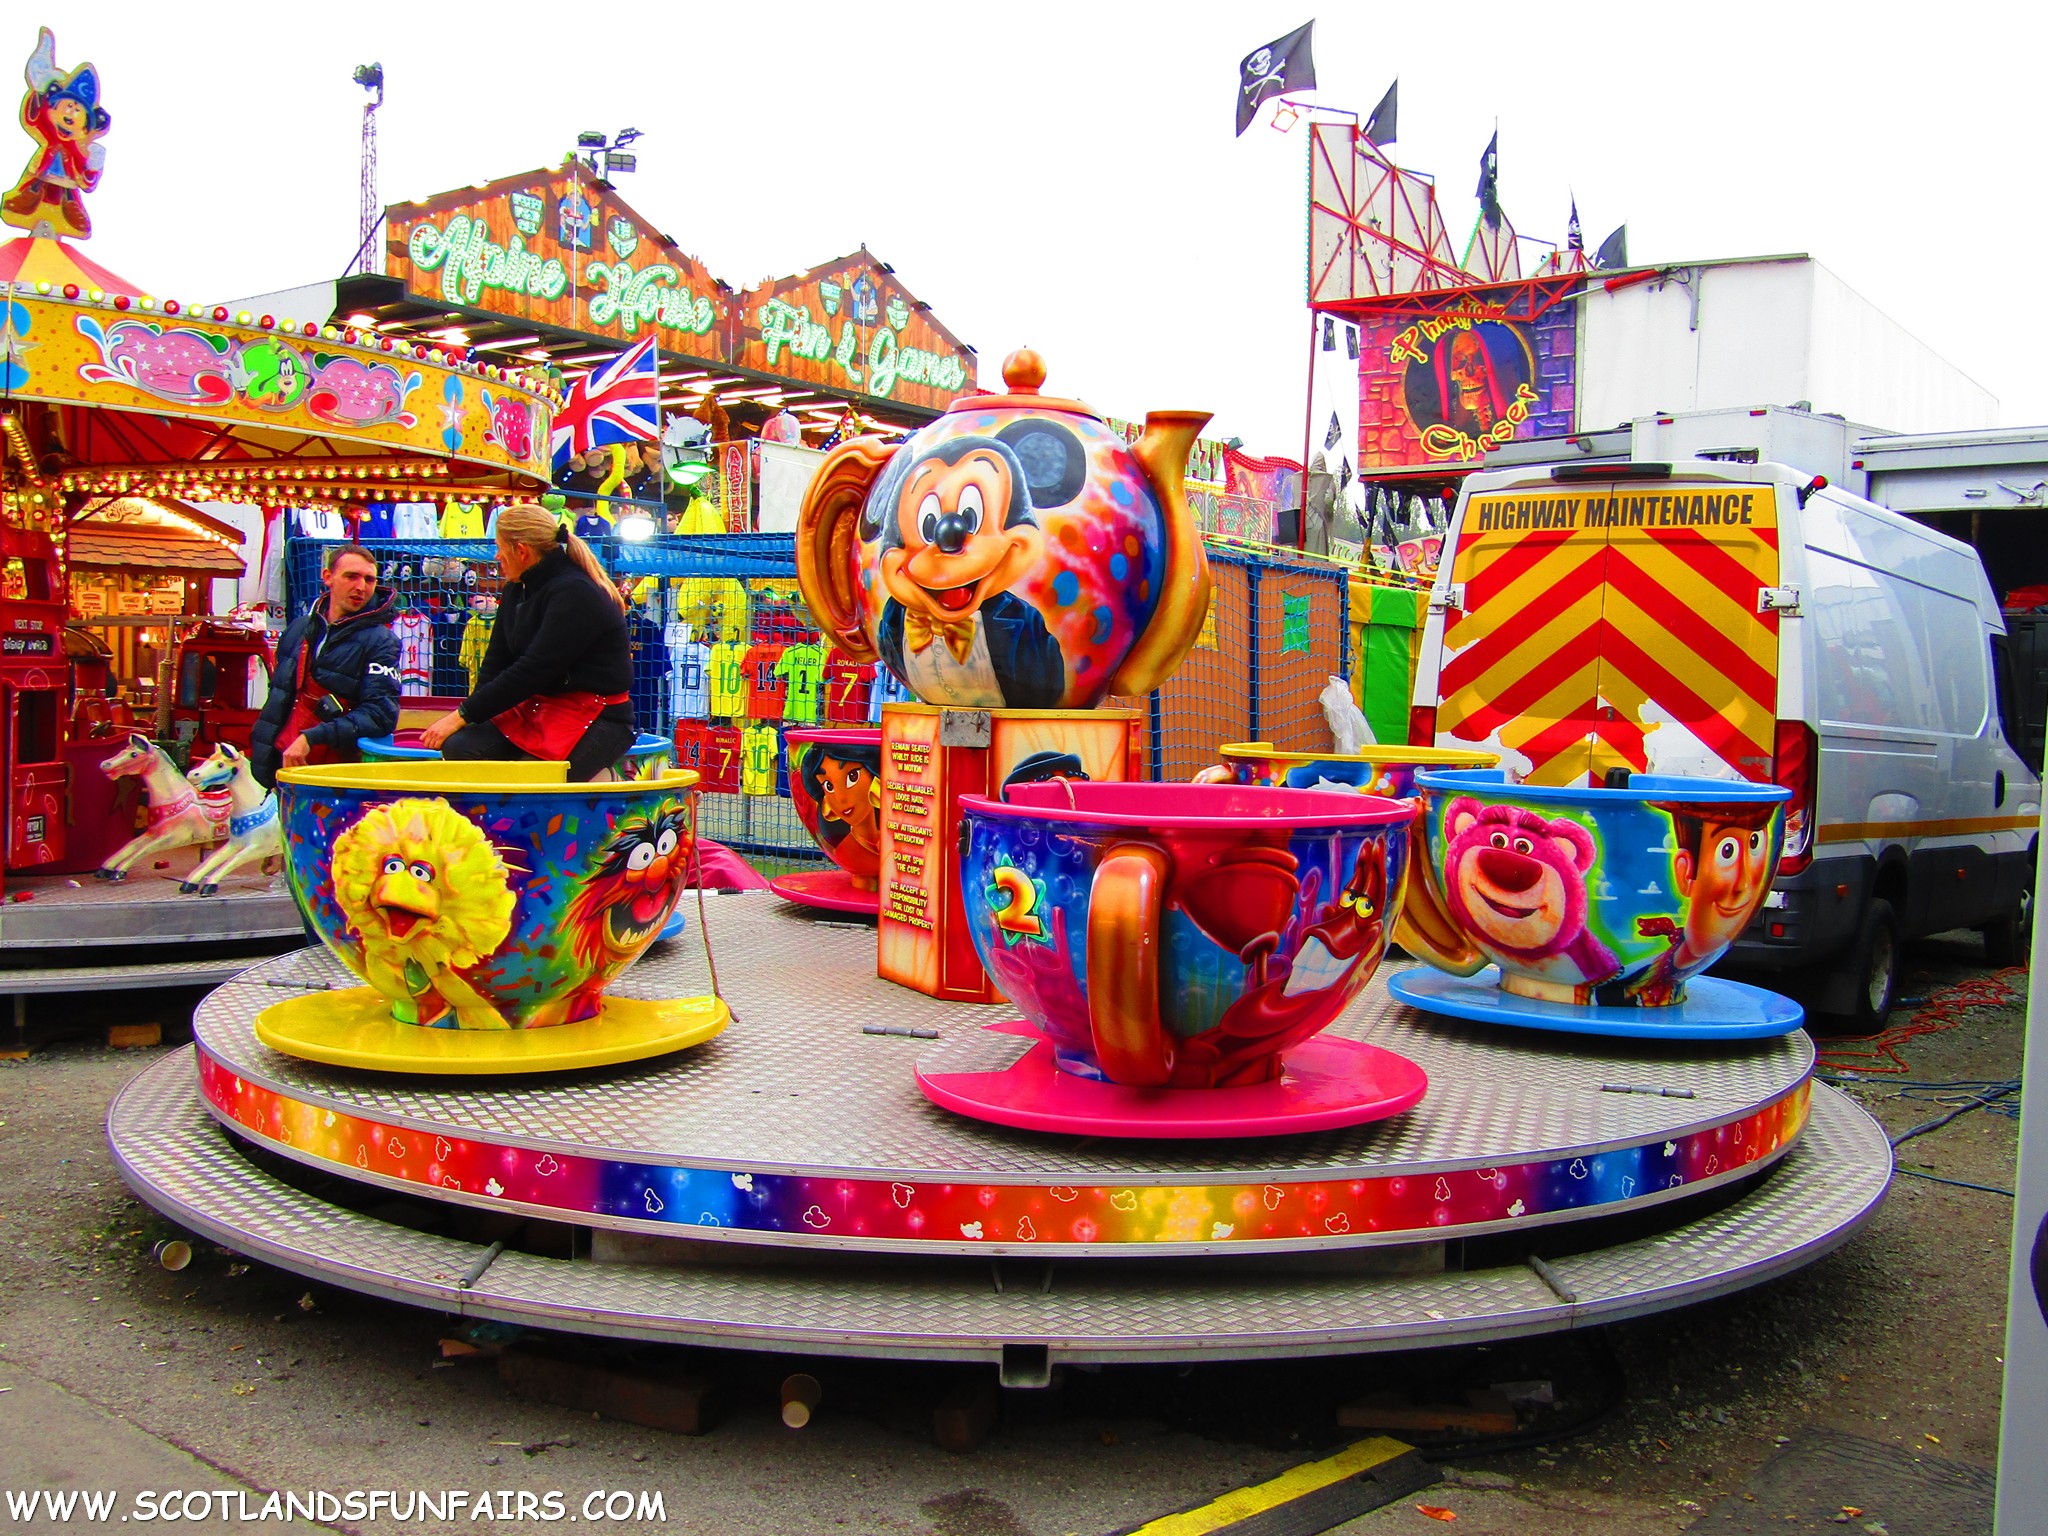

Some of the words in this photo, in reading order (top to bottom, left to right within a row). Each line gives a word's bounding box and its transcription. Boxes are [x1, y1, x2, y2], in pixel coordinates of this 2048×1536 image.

[409, 214, 570, 306] Alpine
[585, 261, 716, 336] House
[758, 297, 833, 366] Fun
[868, 326, 967, 399] Games
[1420, 383, 1541, 462] Chaser
[1478, 498, 1581, 531] HIGHWAY
[1584, 494, 1754, 527] MAINTENANCE
[368, 662, 402, 684] DKN
[720, 663, 740, 695] 10
[757, 662, 778, 692] 14
[798, 670, 810, 695] 1
[837, 673, 859, 707] 7
[892, 742, 911, 752] REMAIN
[911, 743, 931, 753] SEATED
[911, 753, 923, 763] RIDE
[719, 748, 732, 779] 7
[904, 763, 923, 773] MOTION
[886, 781, 905, 791] SECURE
[895, 792, 910, 802] LOOSE
[903, 804, 928, 816] CLOTHING
[887, 820, 899, 831] OBEY
[901, 823, 933, 837] ATTENDANTS
[907, 865, 921, 876] CUPS
[912, 856, 925, 866] SPIN
[899, 883, 919, 895] ACCEPT
[993, 866, 1041, 934] 2
[883, 908, 907, 923] DAMAGED
[908, 915, 935, 931] PROPERTY
[903, 904, 915, 914] LOST
